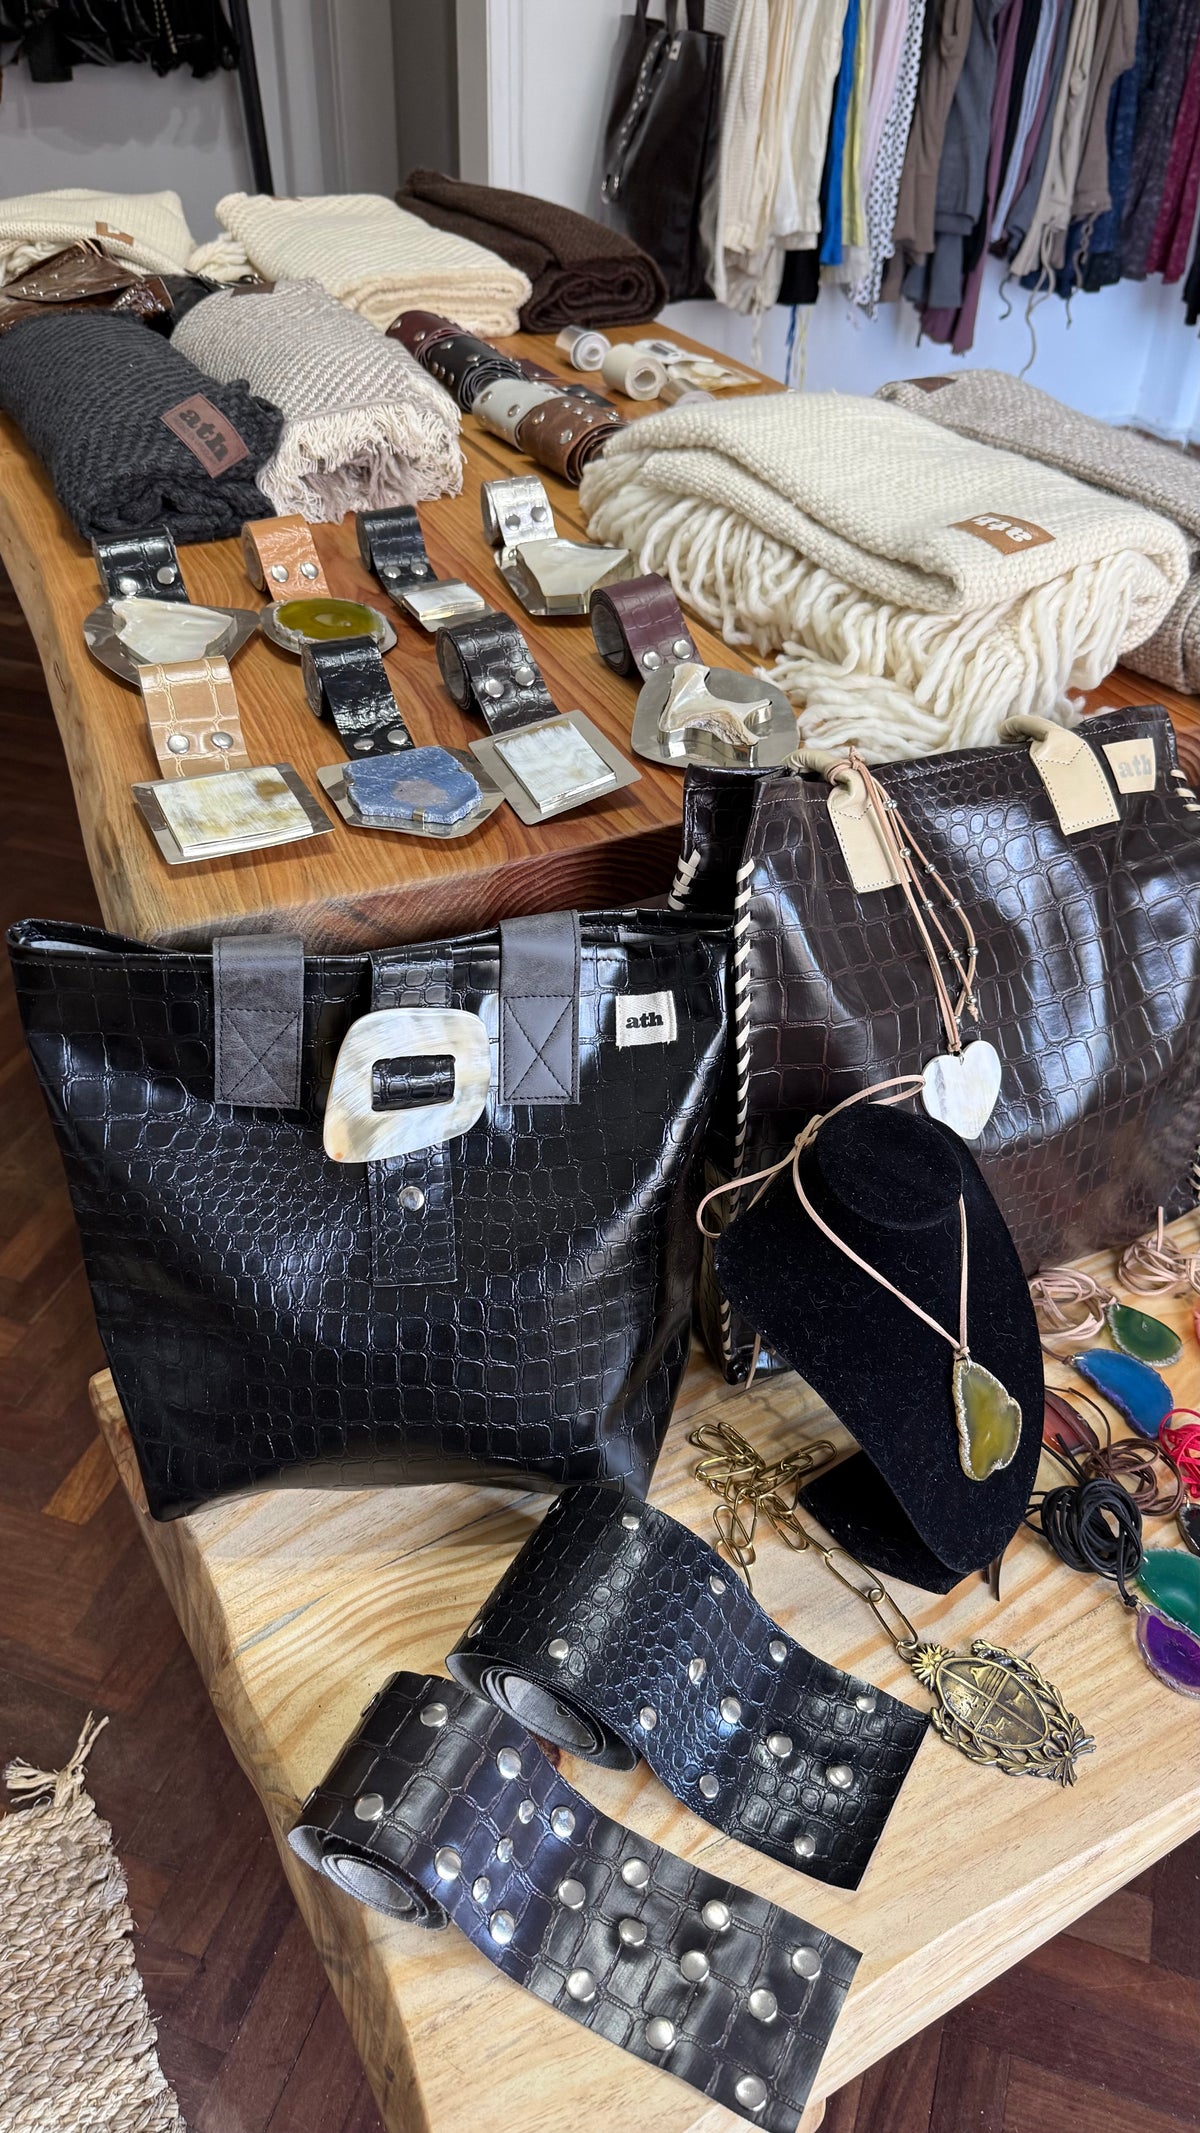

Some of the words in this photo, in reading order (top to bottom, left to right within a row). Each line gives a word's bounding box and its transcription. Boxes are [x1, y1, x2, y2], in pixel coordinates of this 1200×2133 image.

[179, 409, 229, 462] ath
[972, 516, 1032, 542] ath
[1118, 754, 1152, 778] ath
[625, 1012, 664, 1028] ath
